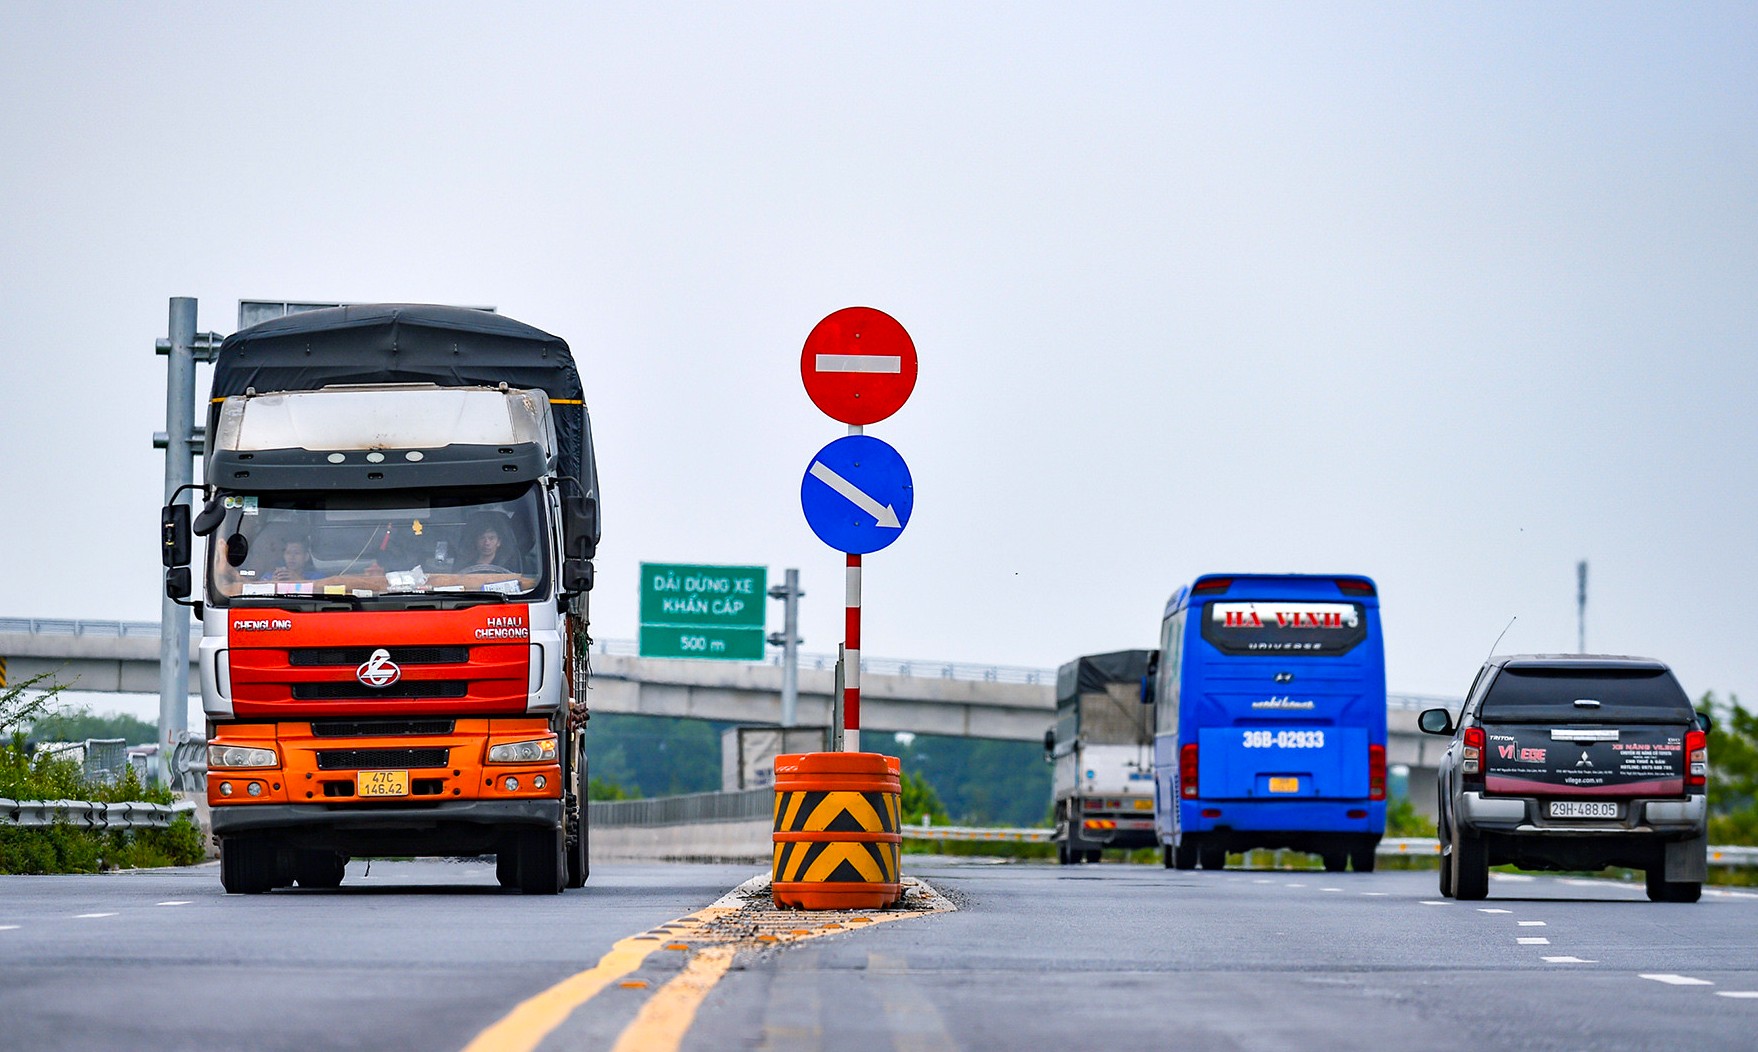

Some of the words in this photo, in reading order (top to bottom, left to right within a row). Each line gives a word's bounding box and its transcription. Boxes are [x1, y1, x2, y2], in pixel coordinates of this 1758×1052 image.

[654, 570, 680, 592] DẢI
[685, 573, 730, 594] DỪNG
[734, 578, 753, 594] XE
[712, 595, 745, 615] CẤP
[487, 616, 522, 627] HAIAU
[1223, 603, 1264, 628] HÀ
[1275, 611, 1343, 629] VINH
[233, 619, 292, 631] CHENGLONG
[474, 627, 529, 639] CHENGONG
[681, 636, 706, 651] 500
[711, 640, 725, 652] m
[1248, 642, 1322, 650] UNIVERSE
[1242, 731, 1325, 749] 36B-02933
[373, 773, 393, 782] 47C
[365, 783, 402, 794] 146.42
[1552, 803, 1616, 816] 29H-488.05
